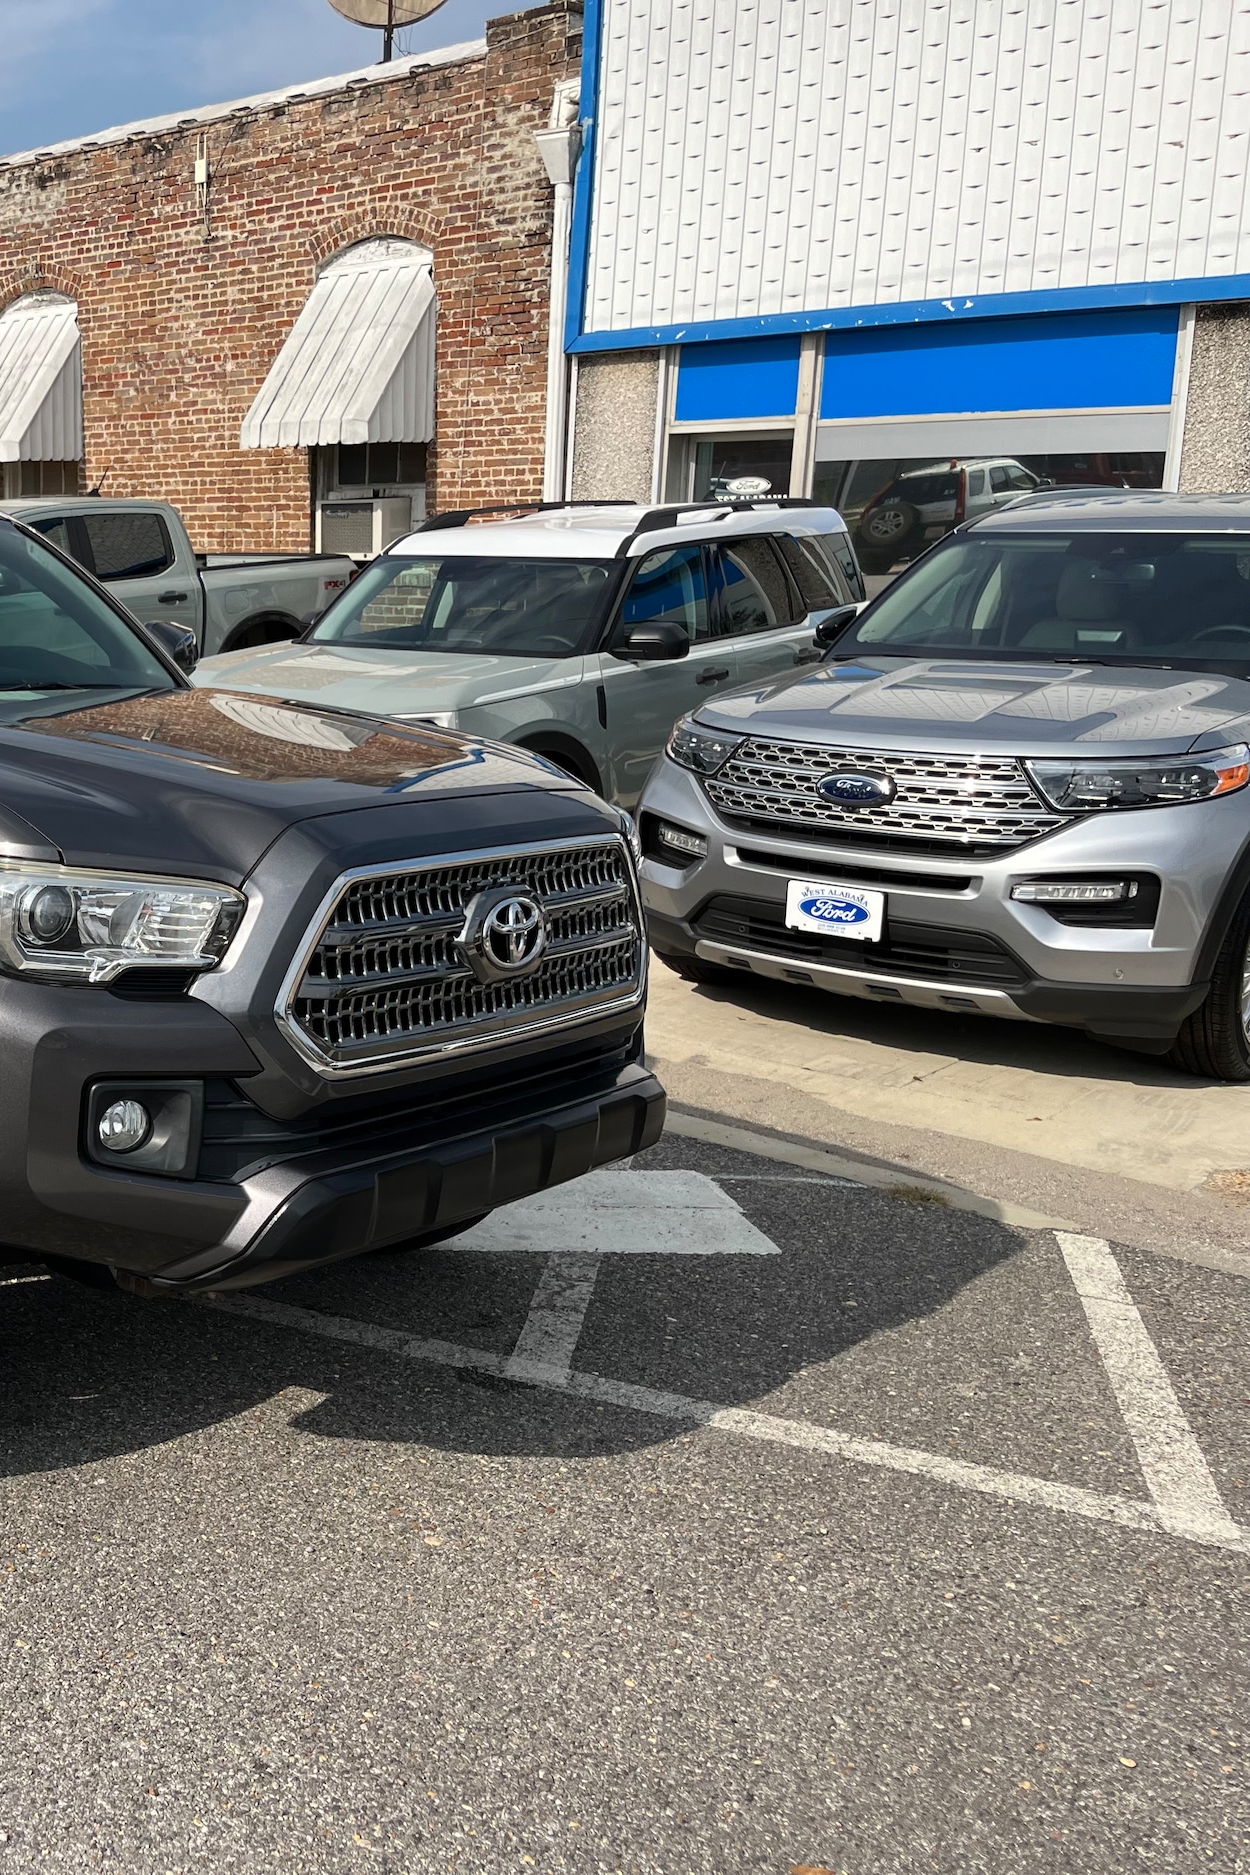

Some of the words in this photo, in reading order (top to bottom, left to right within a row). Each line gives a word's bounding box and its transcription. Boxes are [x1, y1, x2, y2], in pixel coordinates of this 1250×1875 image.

[801, 888, 826, 898] WEST
[828, 889, 869, 907] ALABAMA
[810, 898, 858, 922] Ford
